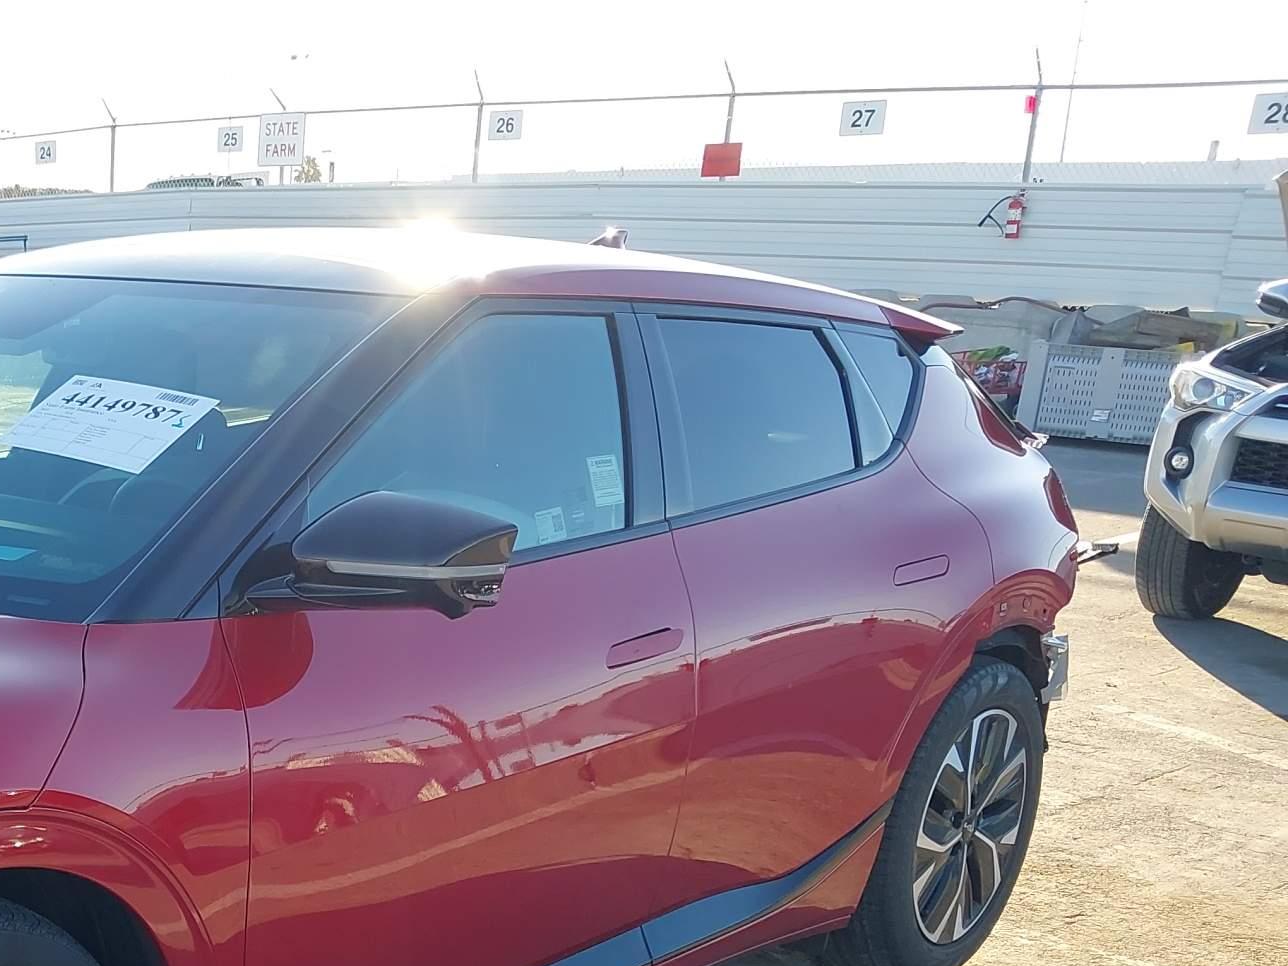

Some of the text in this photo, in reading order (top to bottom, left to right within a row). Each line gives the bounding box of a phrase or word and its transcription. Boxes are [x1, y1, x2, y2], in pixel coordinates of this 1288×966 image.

[496, 117, 515, 133] 26
[850, 109, 876, 128] 27
[265, 121, 299, 136] STATE
[223, 132, 238, 146] 25
[39, 146, 51, 160] 24
[265, 143, 296, 157] FARM
[61, 391, 183, 423] 44149787
